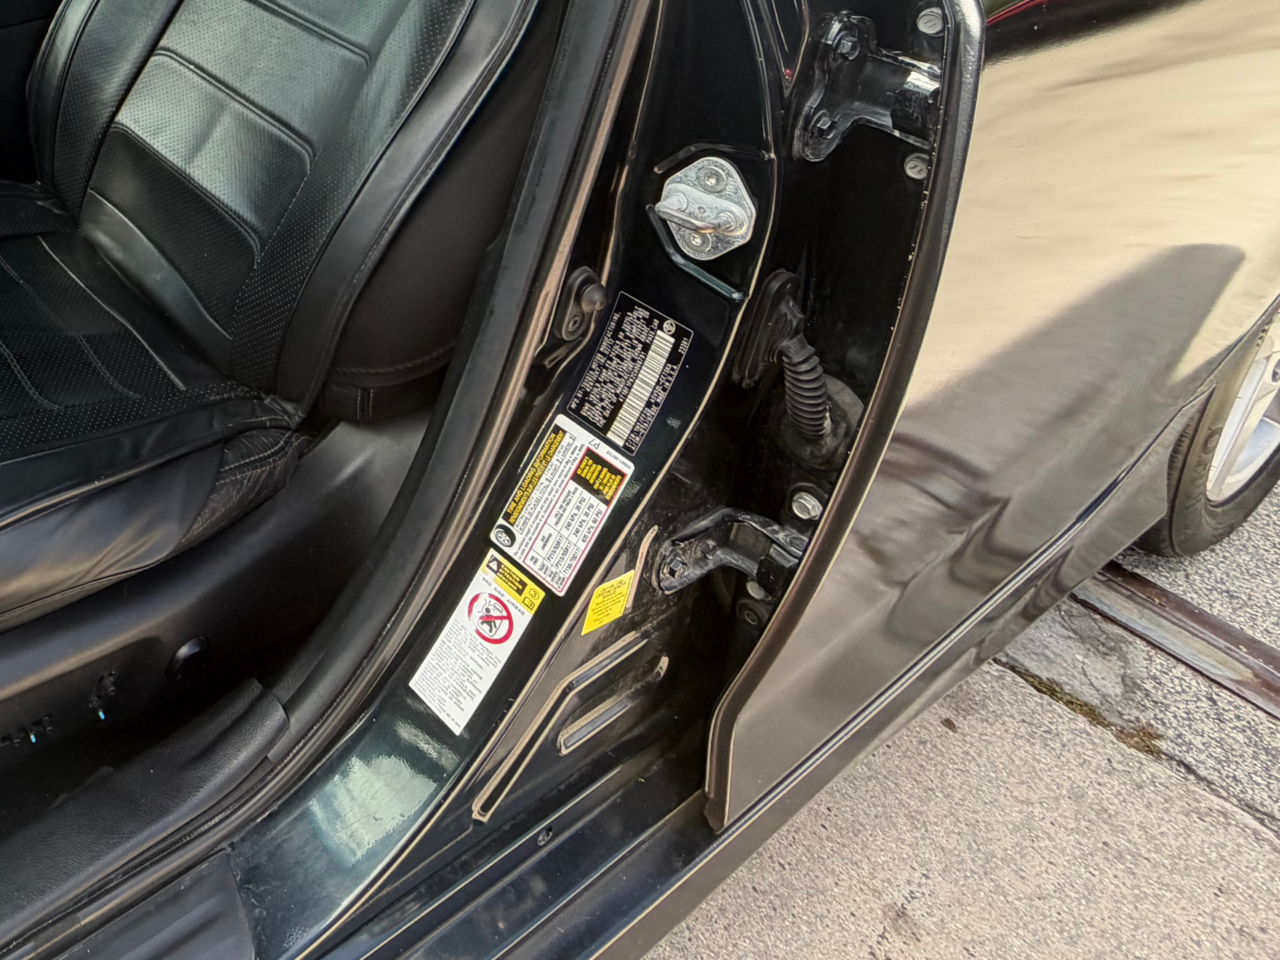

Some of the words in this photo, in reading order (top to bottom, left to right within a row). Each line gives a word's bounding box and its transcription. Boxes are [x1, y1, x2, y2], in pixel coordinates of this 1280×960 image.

[586, 435, 601, 450] P7
[505, 499, 517, 515] TIRE
[512, 488, 523, 503] AND
[519, 466, 536, 491] LOADING
[532, 431, 556, 468] INFORMATION
[505, 597, 526, 616] AIRBAG
